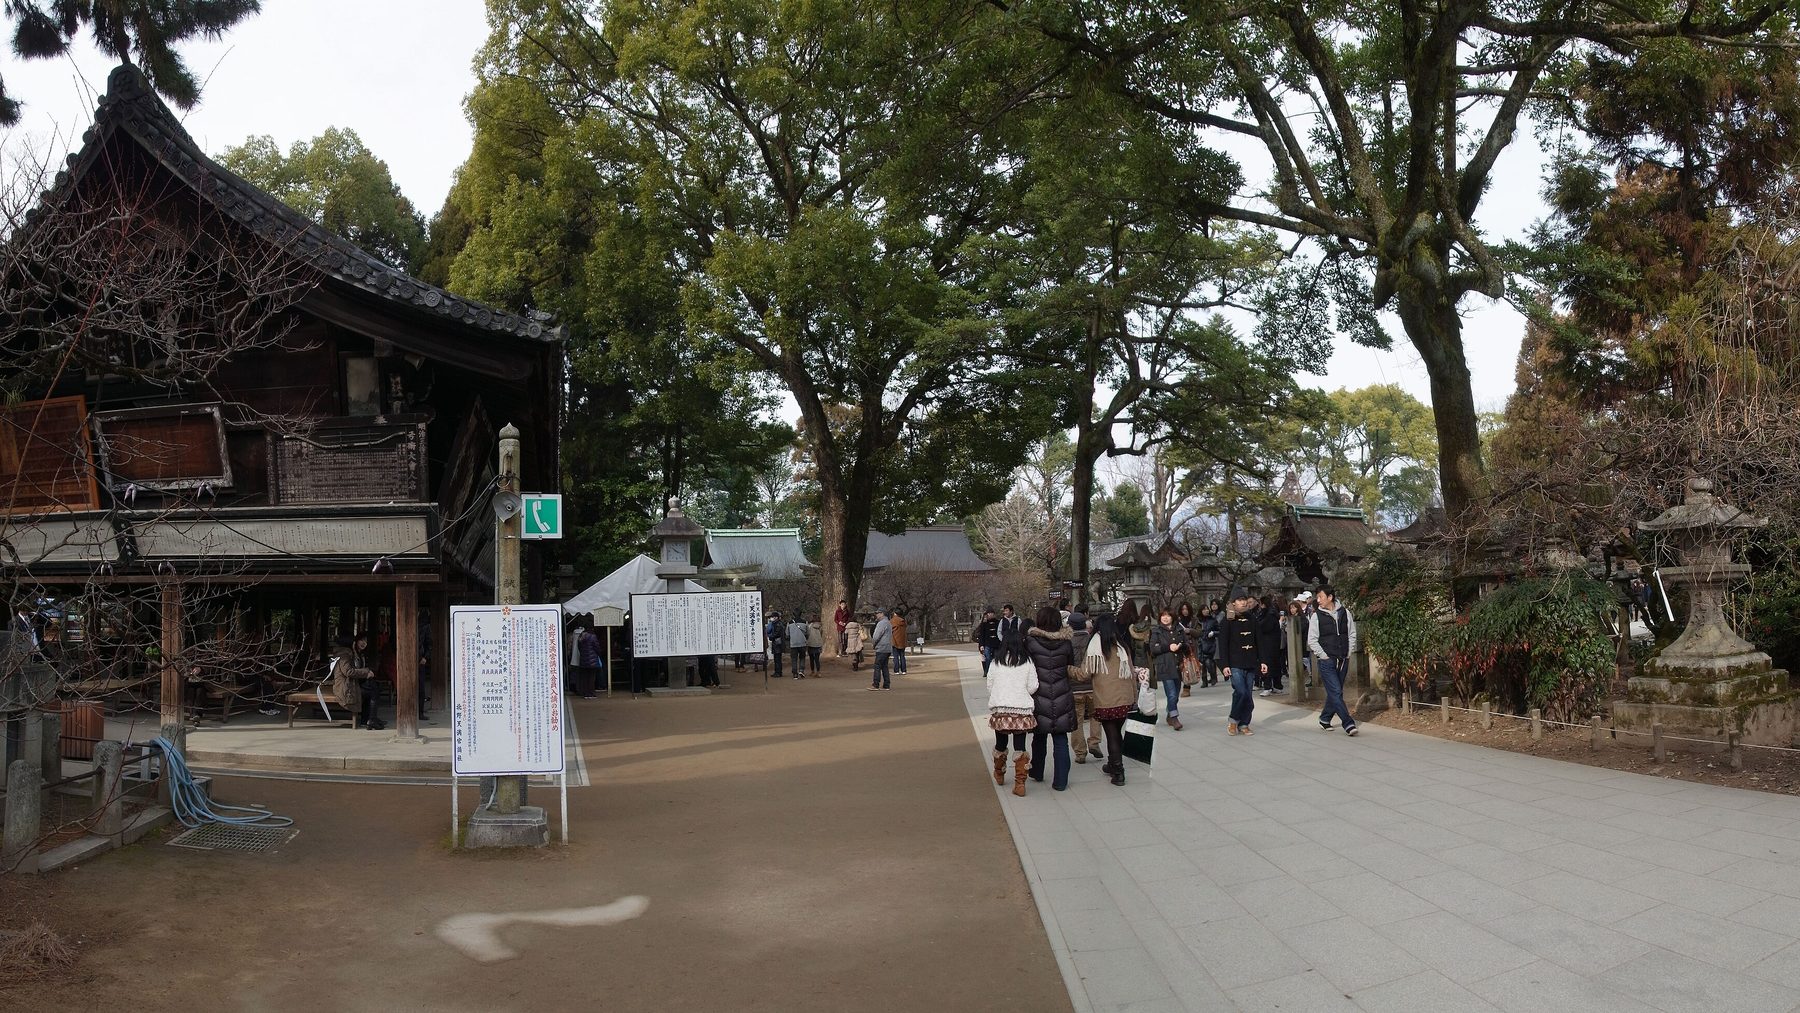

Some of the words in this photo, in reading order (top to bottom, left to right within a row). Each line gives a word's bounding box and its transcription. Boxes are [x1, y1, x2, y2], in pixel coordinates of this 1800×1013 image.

[548, 623, 559, 732] 北野天満宮講社会員入講のお勧め
